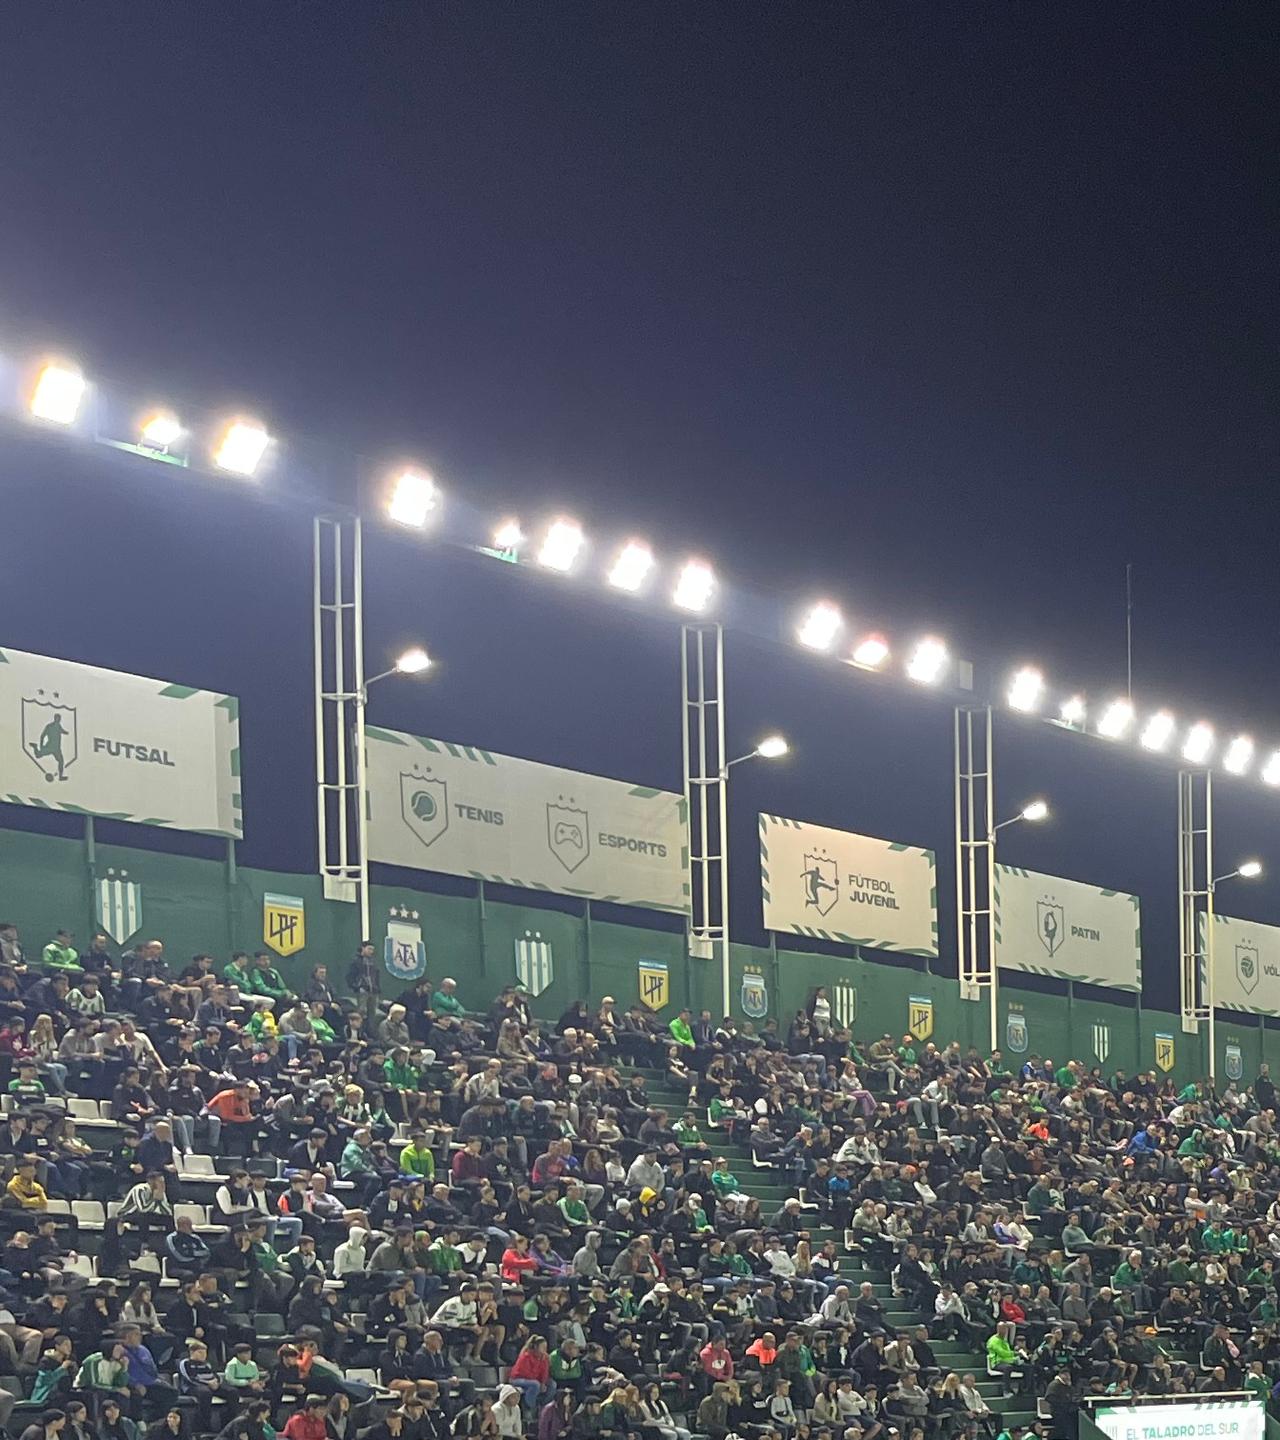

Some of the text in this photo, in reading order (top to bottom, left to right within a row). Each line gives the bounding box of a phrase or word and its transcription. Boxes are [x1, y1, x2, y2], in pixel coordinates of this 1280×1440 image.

[93, 737, 175, 767] FUTSAL
[455, 803, 504, 826] TENIS
[599, 832, 667, 858] ESPORTS
[850, 893, 900, 910] JUVENIL
[1126, 1422, 1239, 1440] EL TALADRO DEL SUR
